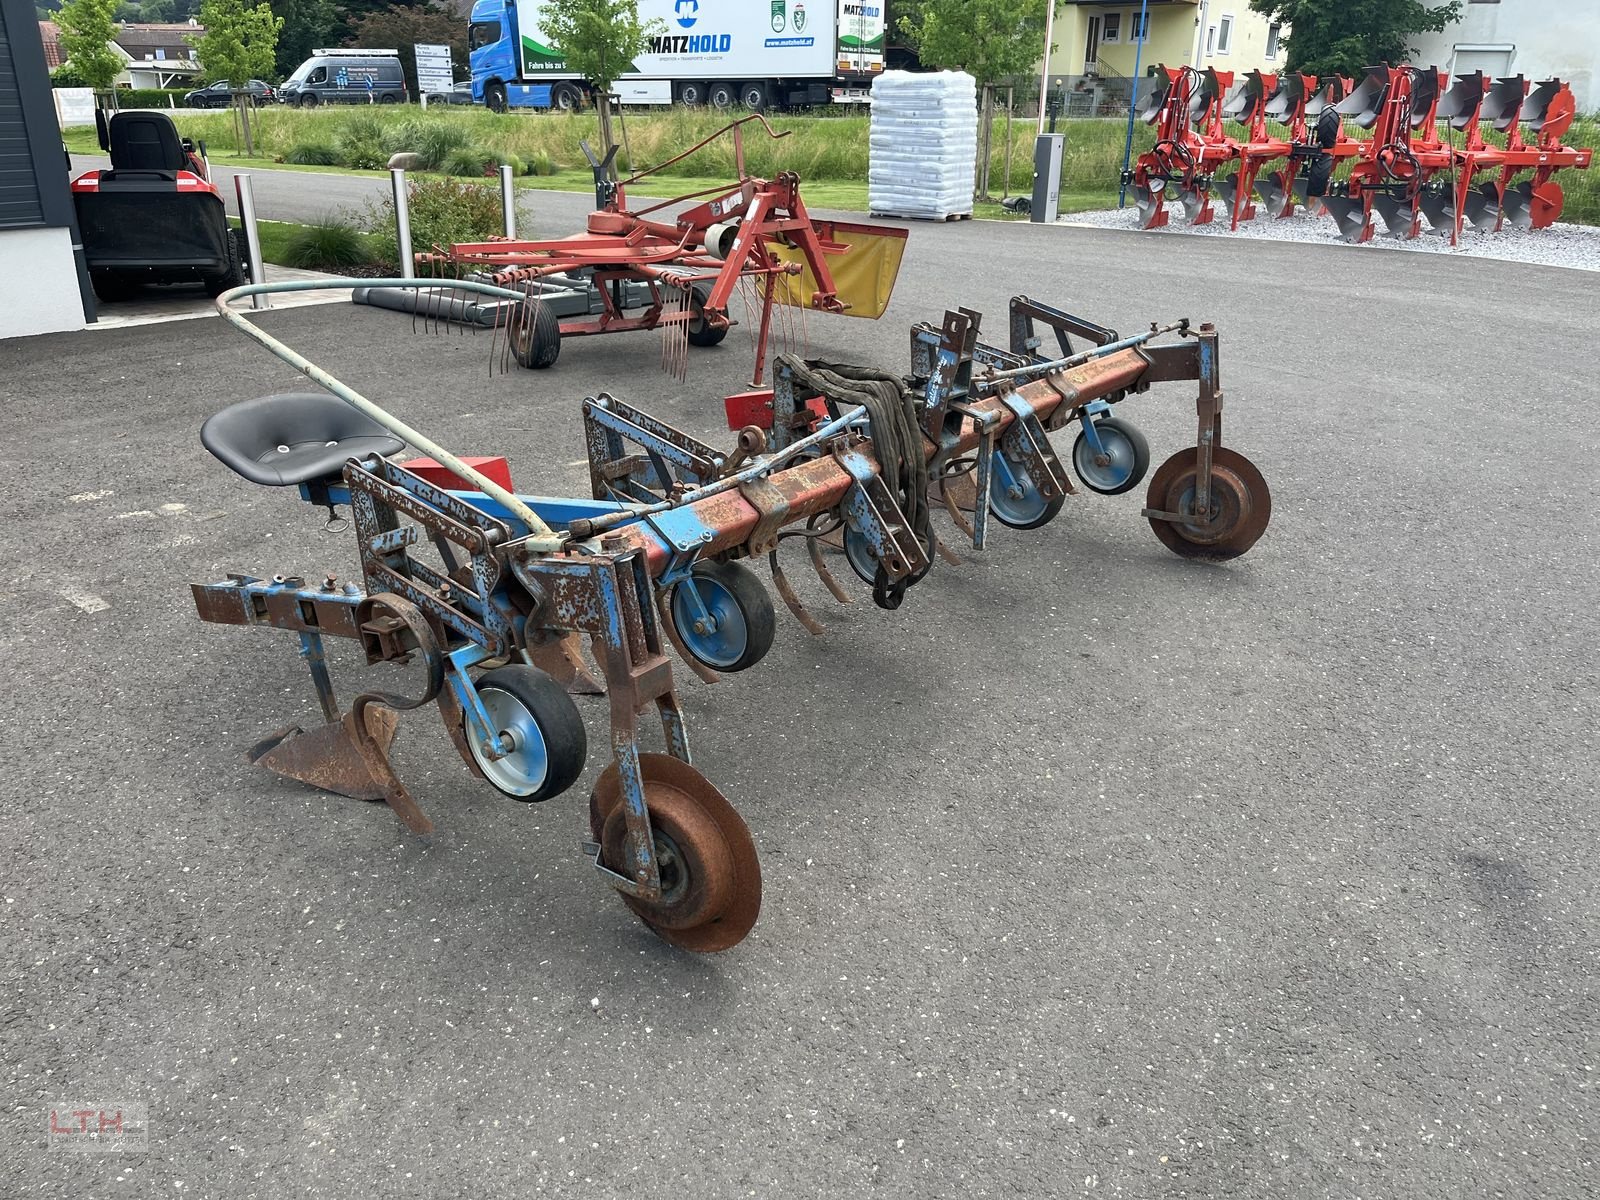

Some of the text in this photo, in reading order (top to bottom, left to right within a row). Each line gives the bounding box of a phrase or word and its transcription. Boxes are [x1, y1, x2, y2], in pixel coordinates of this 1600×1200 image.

[648, 34, 731, 54] MATZHOLD
[528, 61, 544, 69] Fahre
[544, 61, 554, 69] bis
